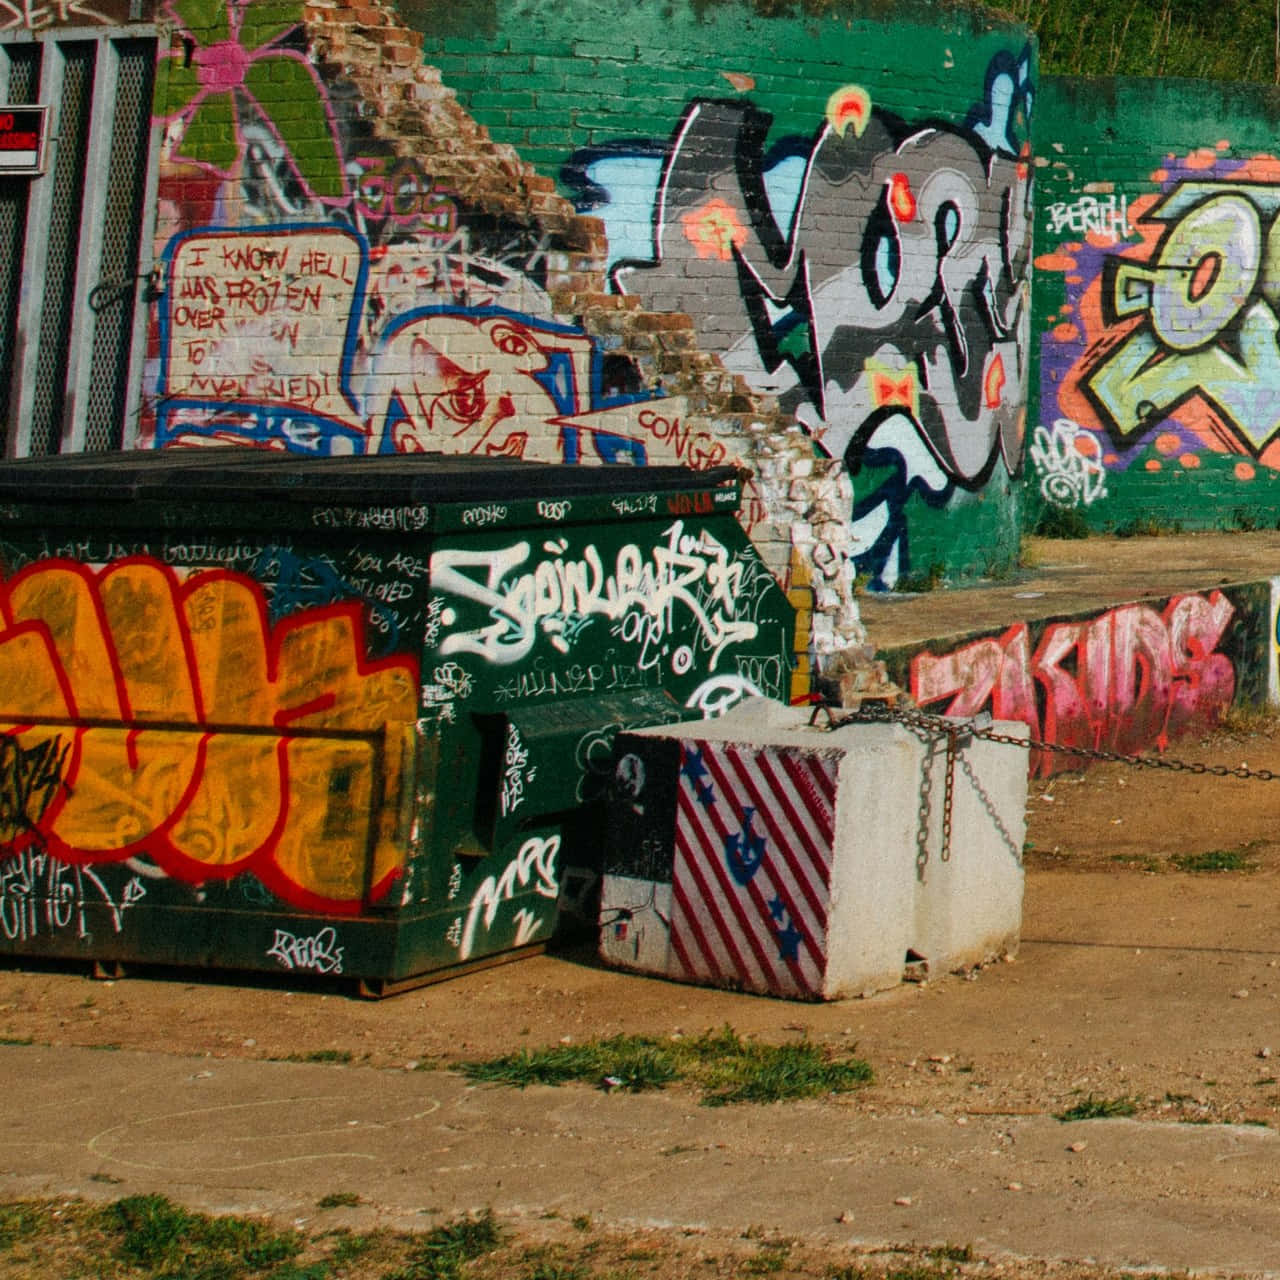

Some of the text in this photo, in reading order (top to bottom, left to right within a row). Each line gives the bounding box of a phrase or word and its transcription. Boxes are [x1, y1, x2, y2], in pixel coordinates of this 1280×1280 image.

[187, 244, 354, 286] I KNOW HELL
[179, 276, 322, 315] HAS FROZEN
[173, 306, 229, 334] OVER
